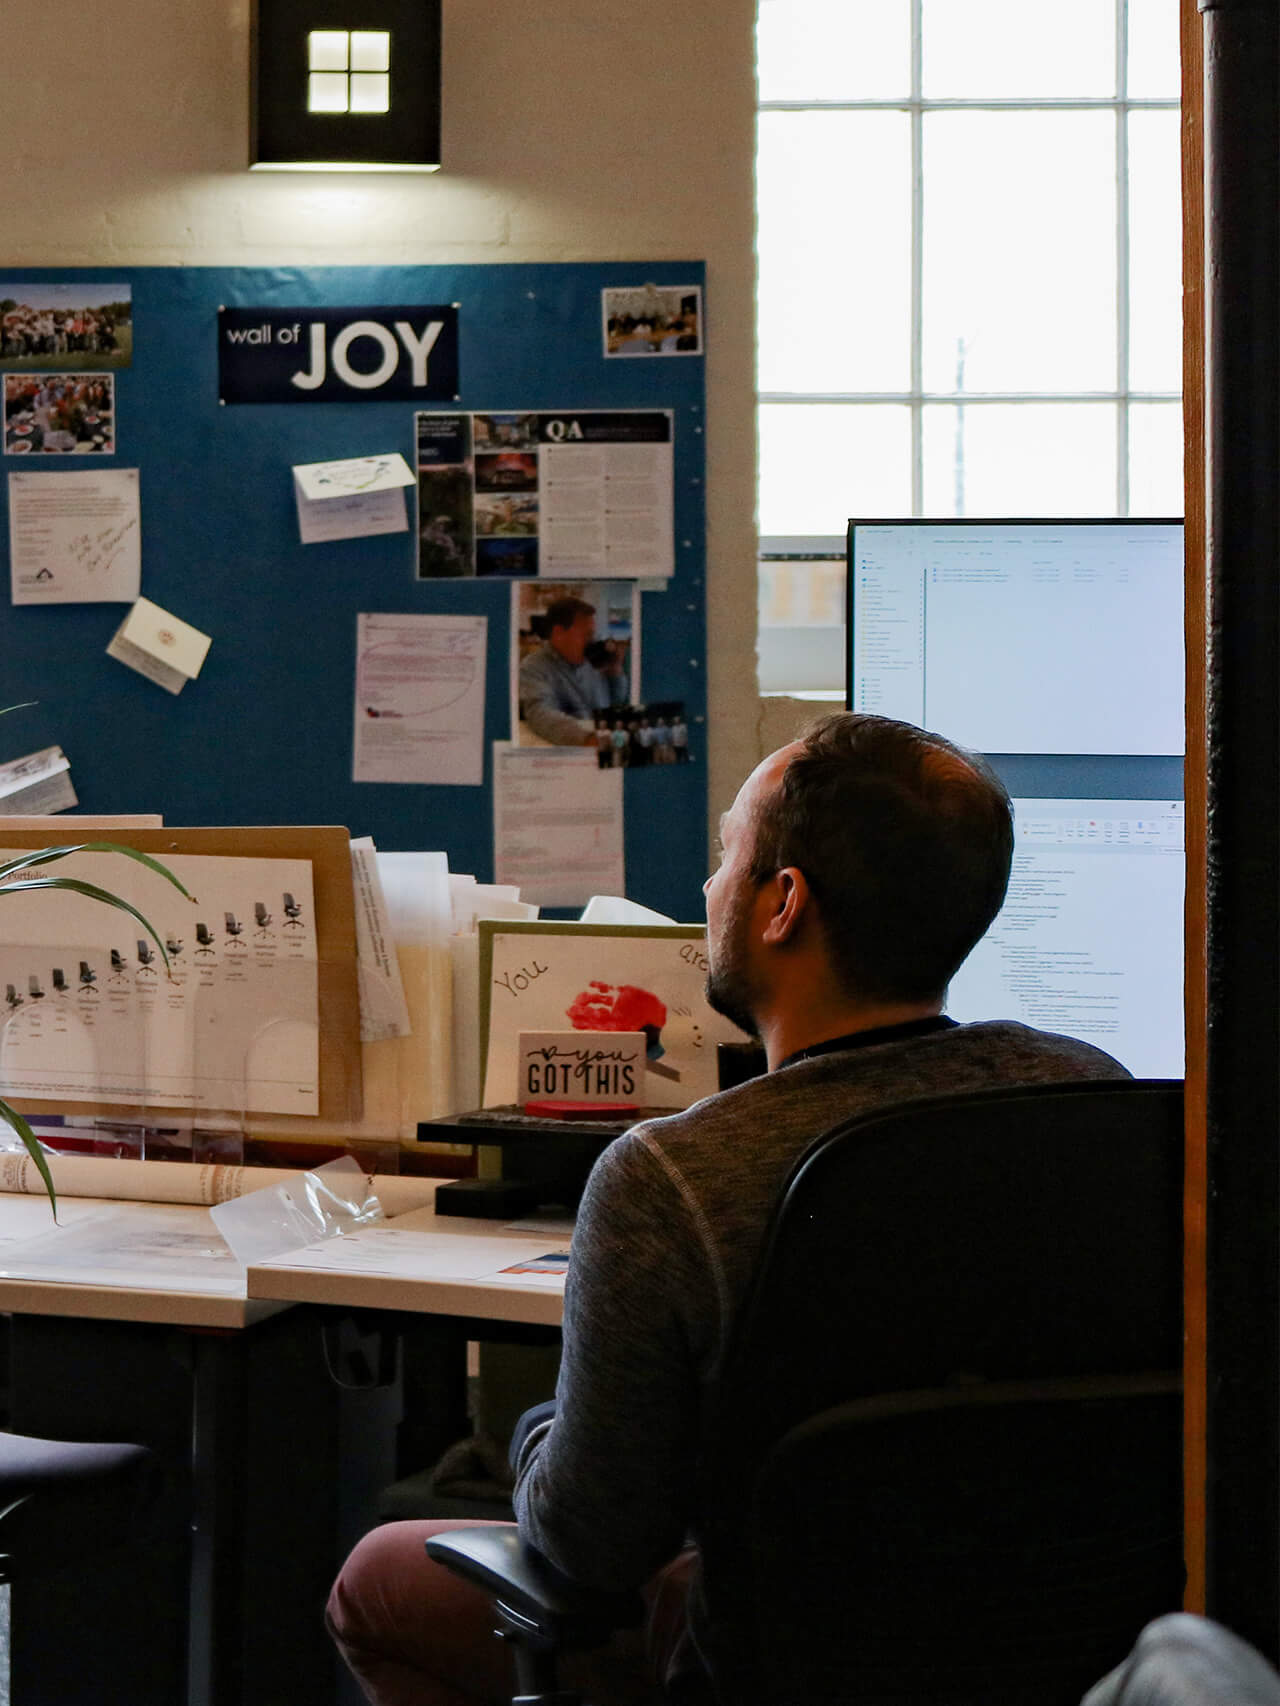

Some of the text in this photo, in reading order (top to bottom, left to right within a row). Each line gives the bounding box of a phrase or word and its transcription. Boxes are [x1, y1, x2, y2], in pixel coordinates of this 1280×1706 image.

[227, 320, 444, 390] wall of JOY
[494, 960, 549, 997] You
[528, 1063, 635, 1094] GOT THIS
[569, 1048, 638, 1078] you
